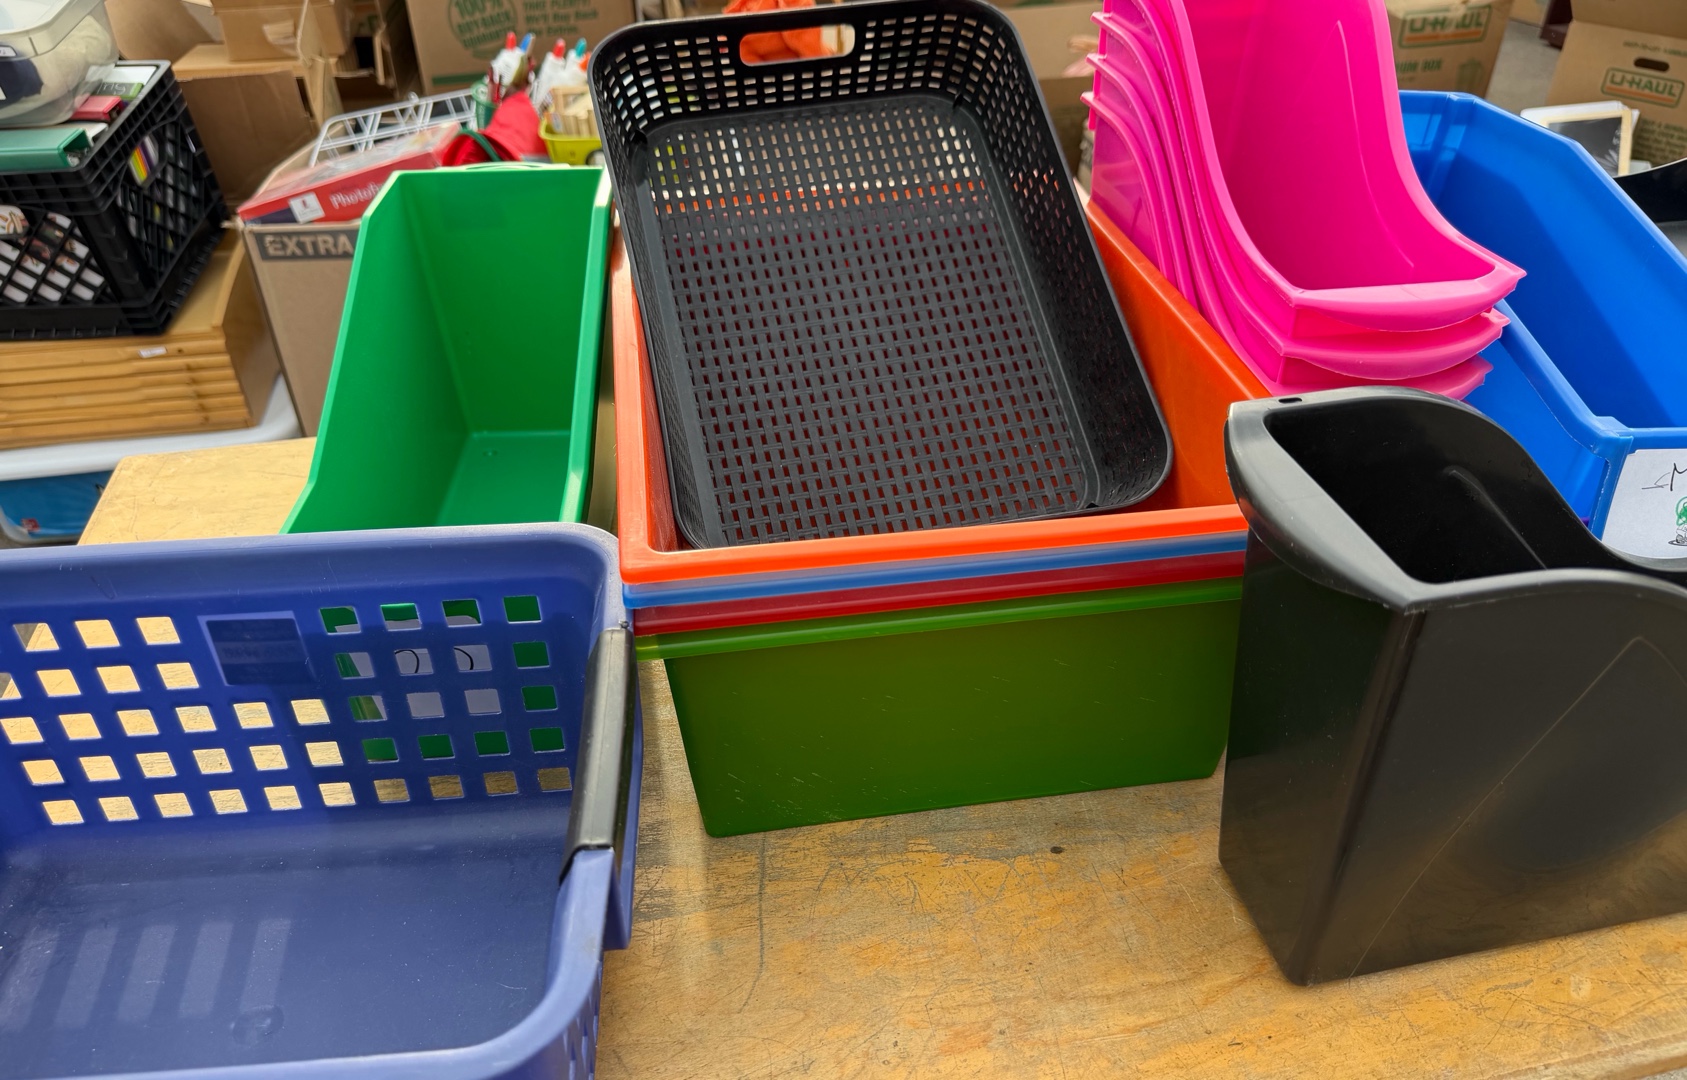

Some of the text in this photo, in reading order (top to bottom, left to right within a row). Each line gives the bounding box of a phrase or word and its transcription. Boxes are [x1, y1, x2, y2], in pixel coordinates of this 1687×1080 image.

[1408, 11, 1483, 33] U-HUL
[1609, 72, 1677, 98] U-HAUL
[264, 234, 353, 257] EXTRA
